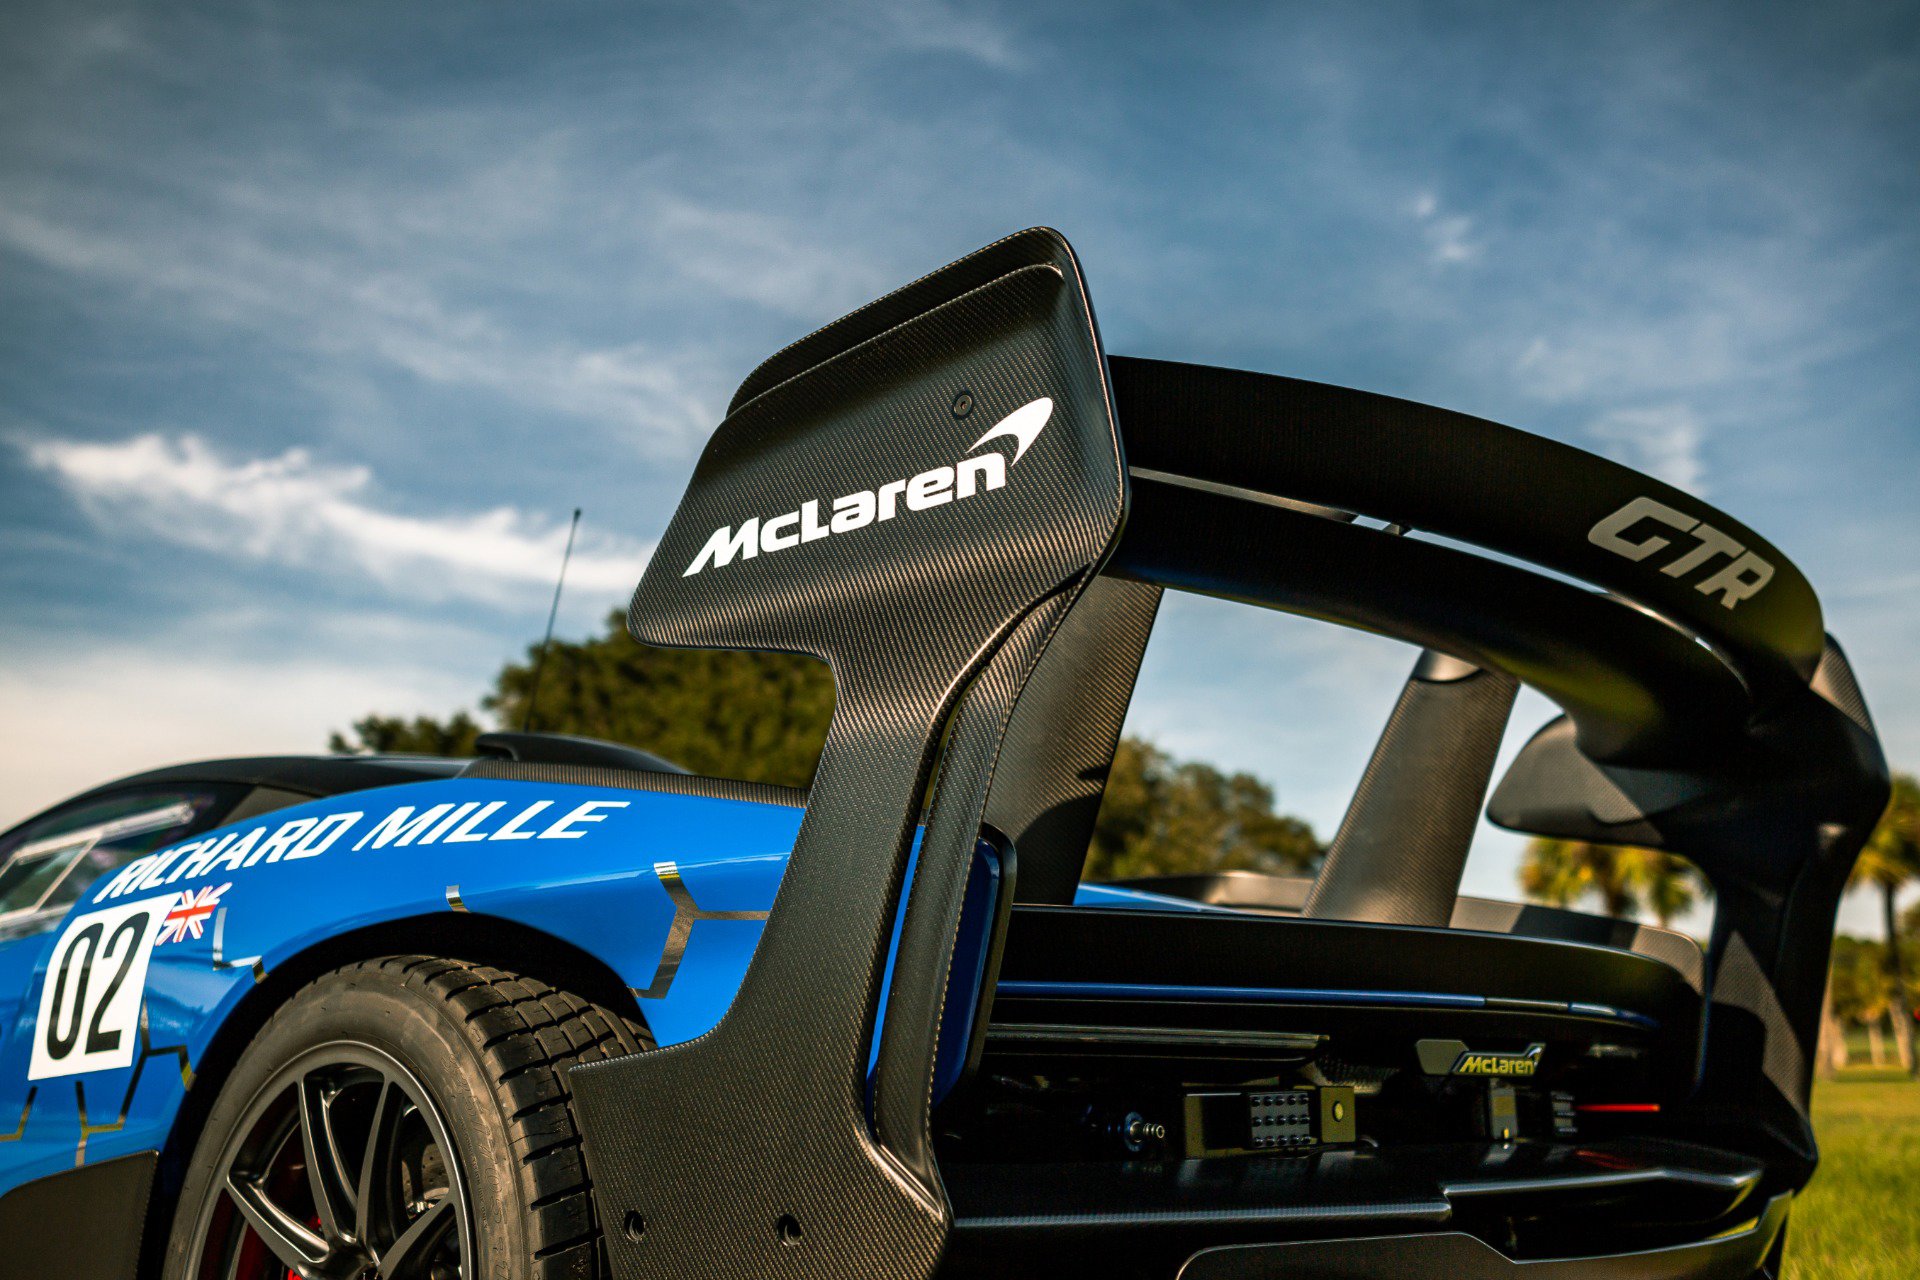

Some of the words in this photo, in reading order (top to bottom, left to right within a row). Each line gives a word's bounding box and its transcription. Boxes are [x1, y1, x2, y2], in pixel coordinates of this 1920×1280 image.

[682, 453, 1006, 578] McLaren
[1587, 496, 1776, 610] GTR
[93, 811, 364, 904] RICHARD
[352, 800, 631, 852] MILLE
[46, 911, 150, 1061] 02
[1459, 1056, 1535, 1074] McLaren
